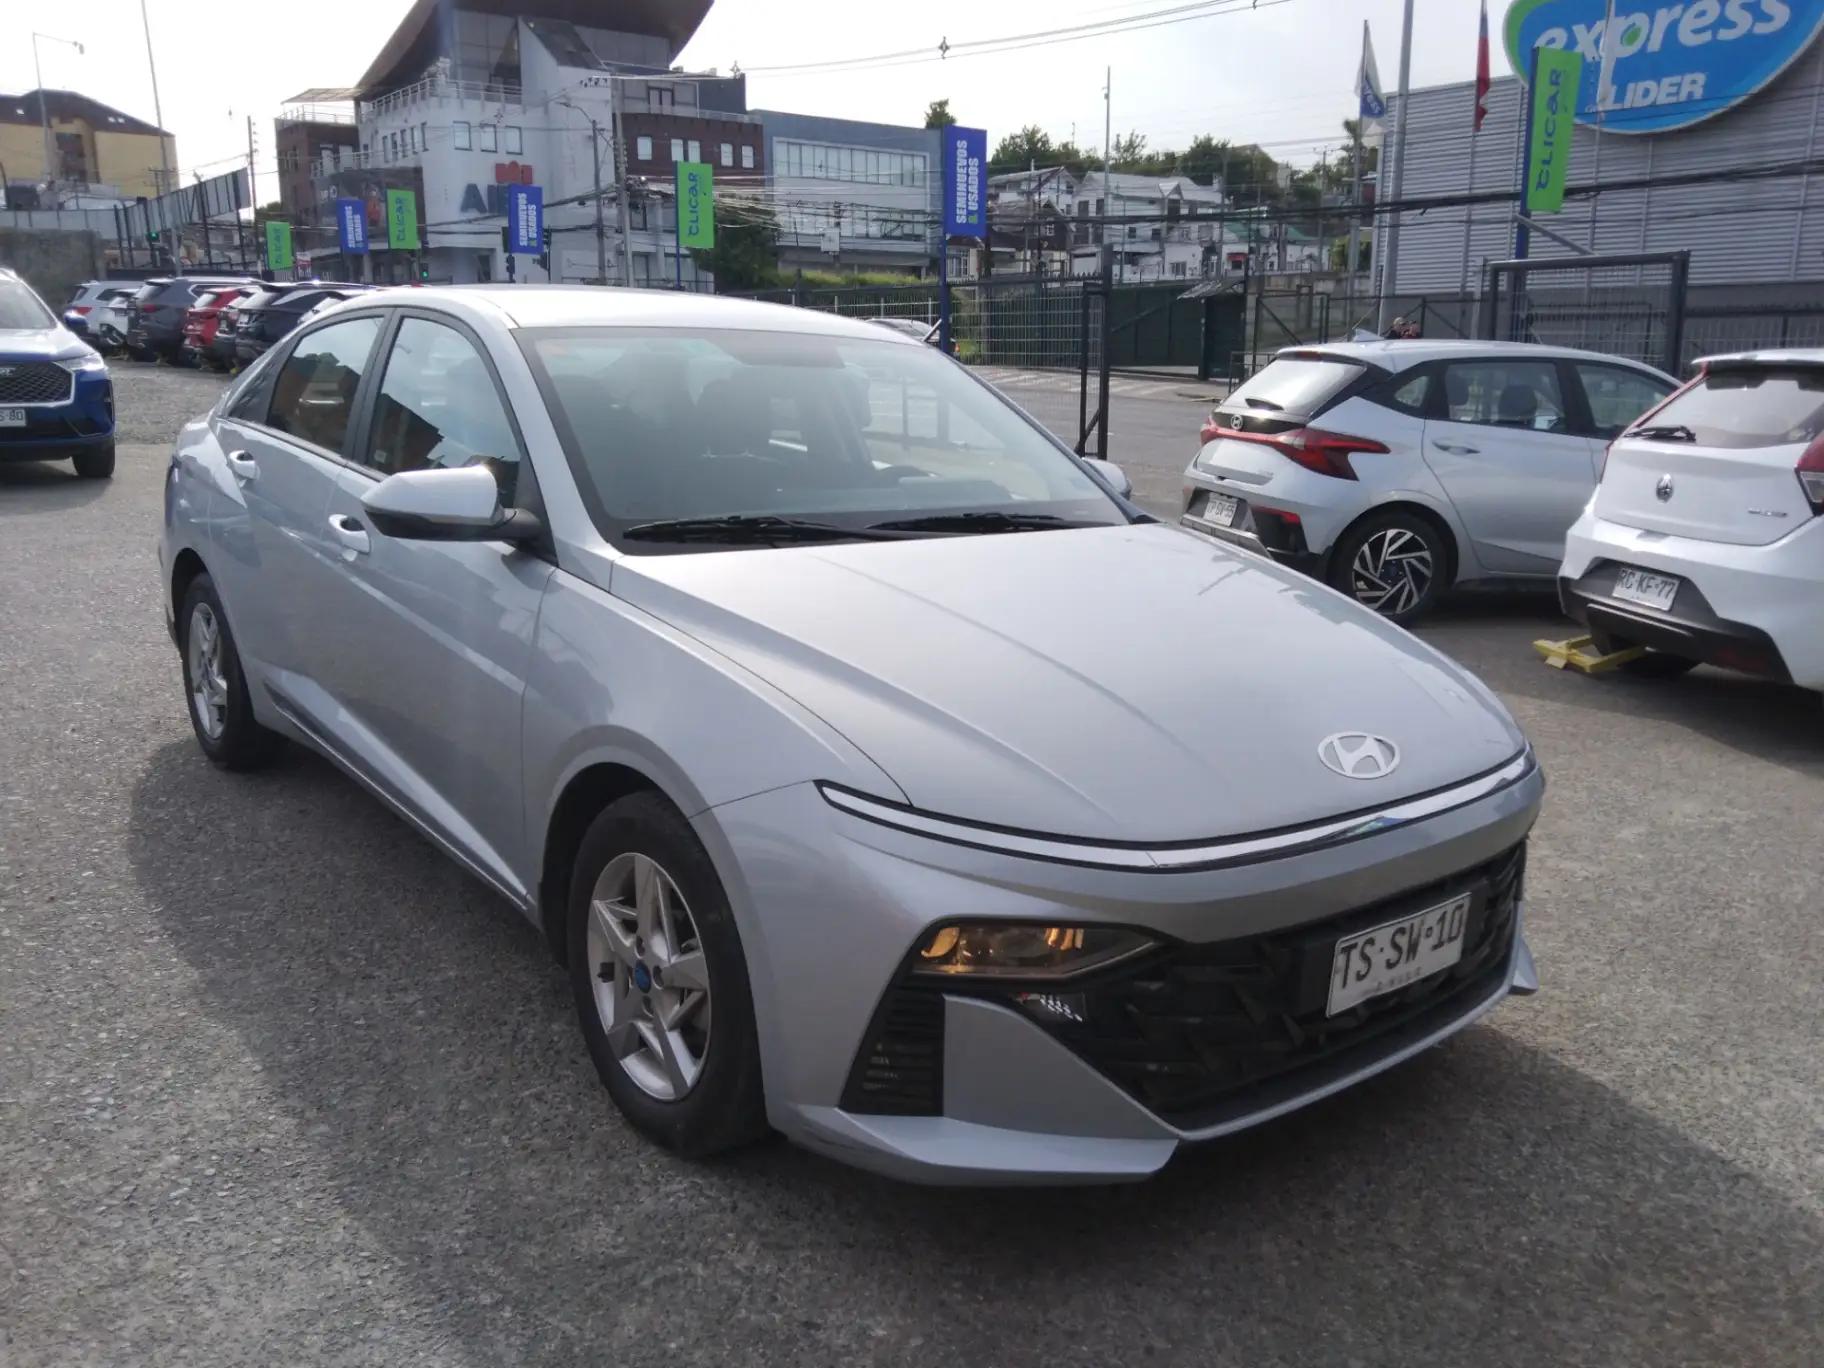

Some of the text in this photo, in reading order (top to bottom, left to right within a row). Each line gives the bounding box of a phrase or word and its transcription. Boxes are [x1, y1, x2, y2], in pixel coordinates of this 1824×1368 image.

[1534, 0, 1791, 62] express
[1603, 72, 1708, 111] LIDER
[956, 140, 967, 224] SEMINUEVOS
[968, 157, 979, 211] USADOS
[518, 192, 528, 247] SEMINUEVOS
[528, 204, 537, 239] USADOS
